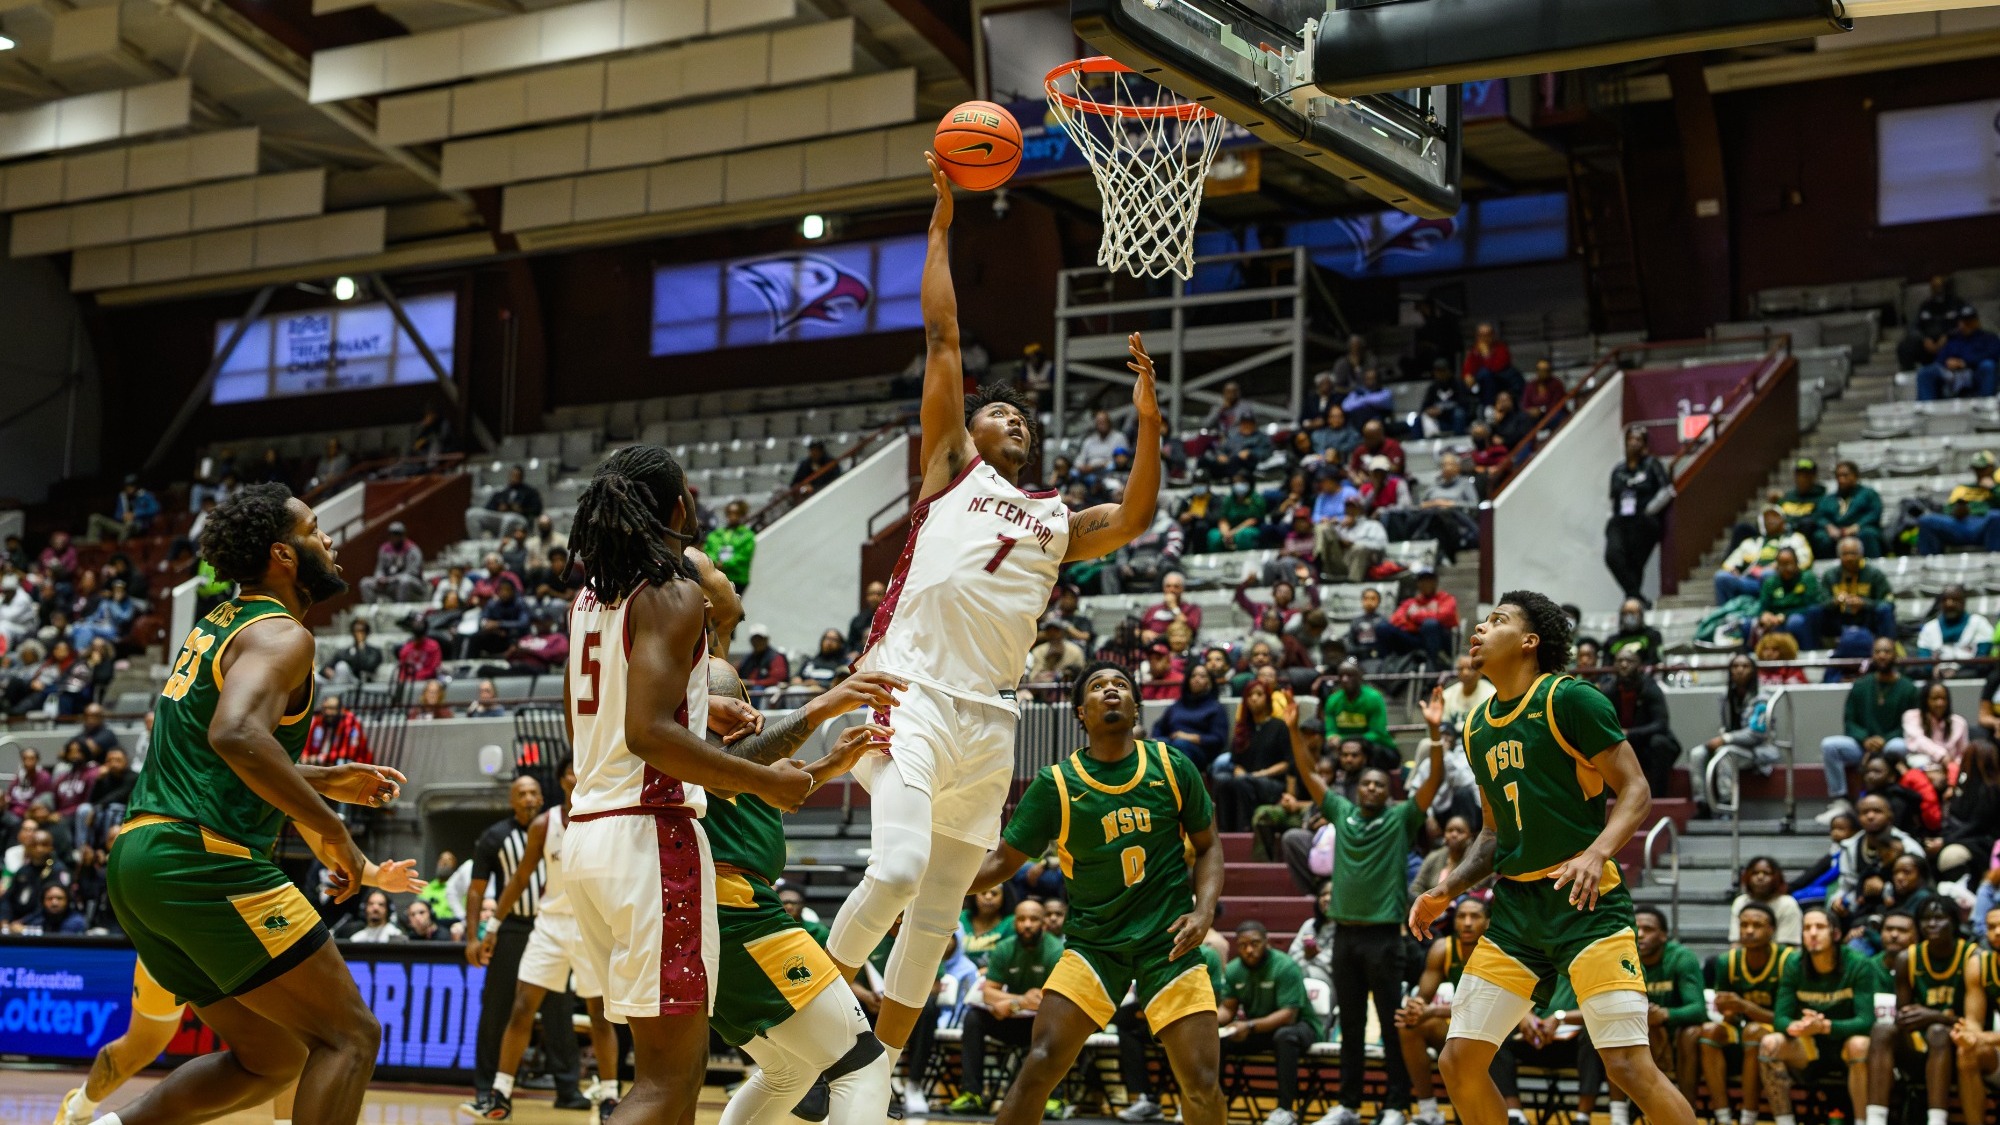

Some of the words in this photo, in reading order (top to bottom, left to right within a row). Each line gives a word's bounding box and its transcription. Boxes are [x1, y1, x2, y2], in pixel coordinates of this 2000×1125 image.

[953, 110, 1000, 129] ELITE
[967, 497, 993, 512] NC
[994, 500, 1054, 554] CENTRAL
[982, 533, 1019, 576] 7
[577, 630, 602, 716] 5
[1485, 739, 1525, 781] NSU
[1101, 806, 1152, 844] NSU
[1503, 781, 1522, 831] 7
[1120, 845, 1147, 888] 0
[16, 967, 84, 991] Education
[0, 988, 113, 1047] ottery
